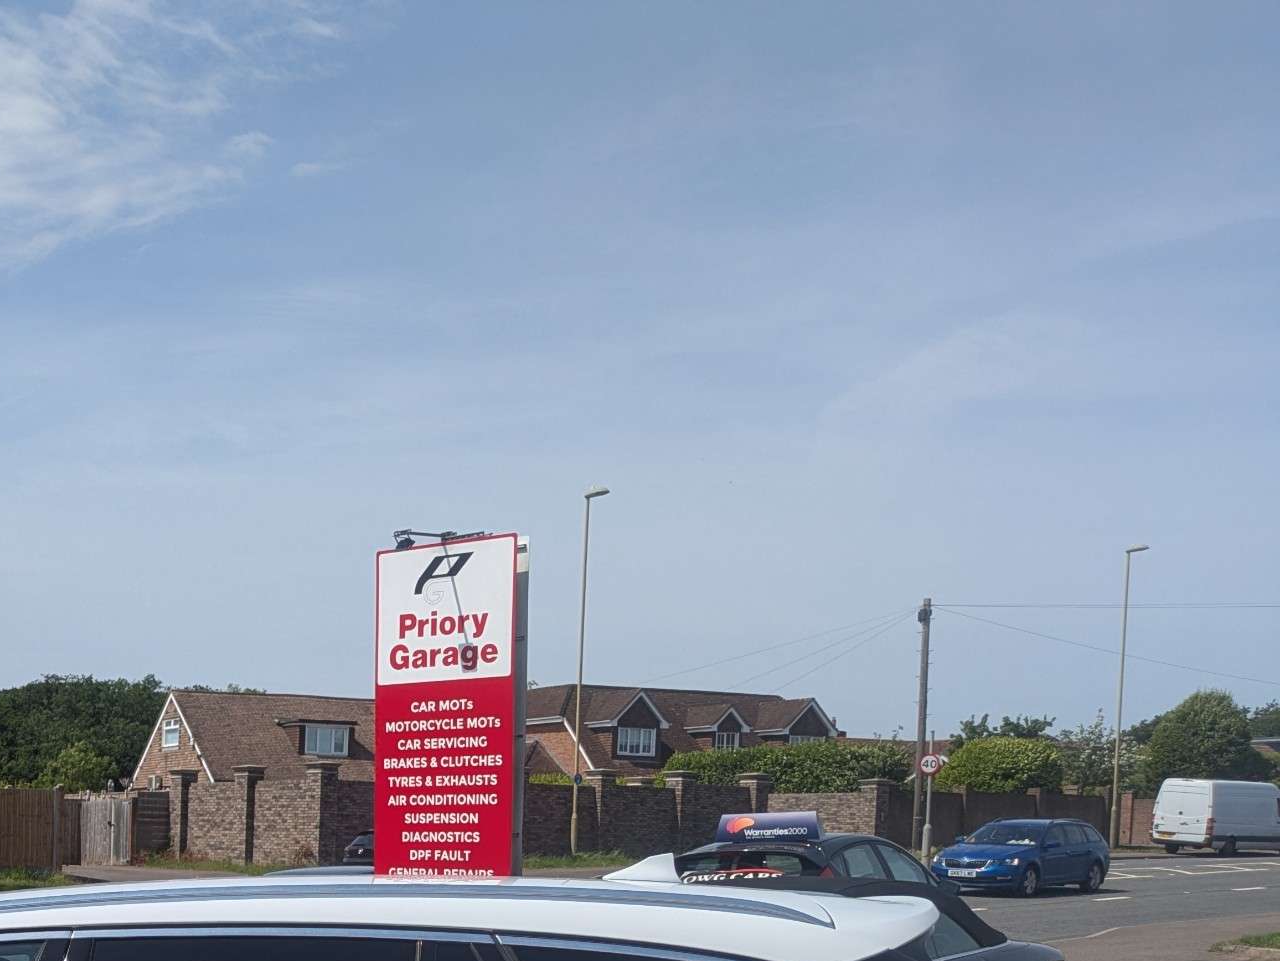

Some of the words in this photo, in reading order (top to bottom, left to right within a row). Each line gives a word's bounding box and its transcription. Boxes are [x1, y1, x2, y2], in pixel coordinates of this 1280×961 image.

[399, 610, 489, 640] Priory
[389, 643, 499, 671] Garage
[410, 700, 436, 713] CAR
[438, 698, 474, 712] MOTs
[385, 718, 464, 733] MOTORCYCLE
[466, 716, 501, 729] MOTs
[397, 738, 421, 751] CAR
[423, 736, 488, 750] SERVICING
[383, 756, 428, 770] BRAKES
[429, 756, 438, 768] &
[440, 754, 503, 767] CLUTCHES
[922, 759, 937, 769] 40
[387, 775, 423, 788] TYRES
[424, 775, 433, 787] &
[435, 774, 498, 787] EXHAUSTS
[387, 794, 407, 807] AIR
[409, 793, 498, 806] CONDITIONING
[404, 812, 479, 824] SUSPENSION
[401, 831, 481, 843] DIAGNOSTICS
[743, 827, 808, 837] Warranties2000
[409, 849, 432, 861] DPF
[434, 849, 472, 862] FAULT
